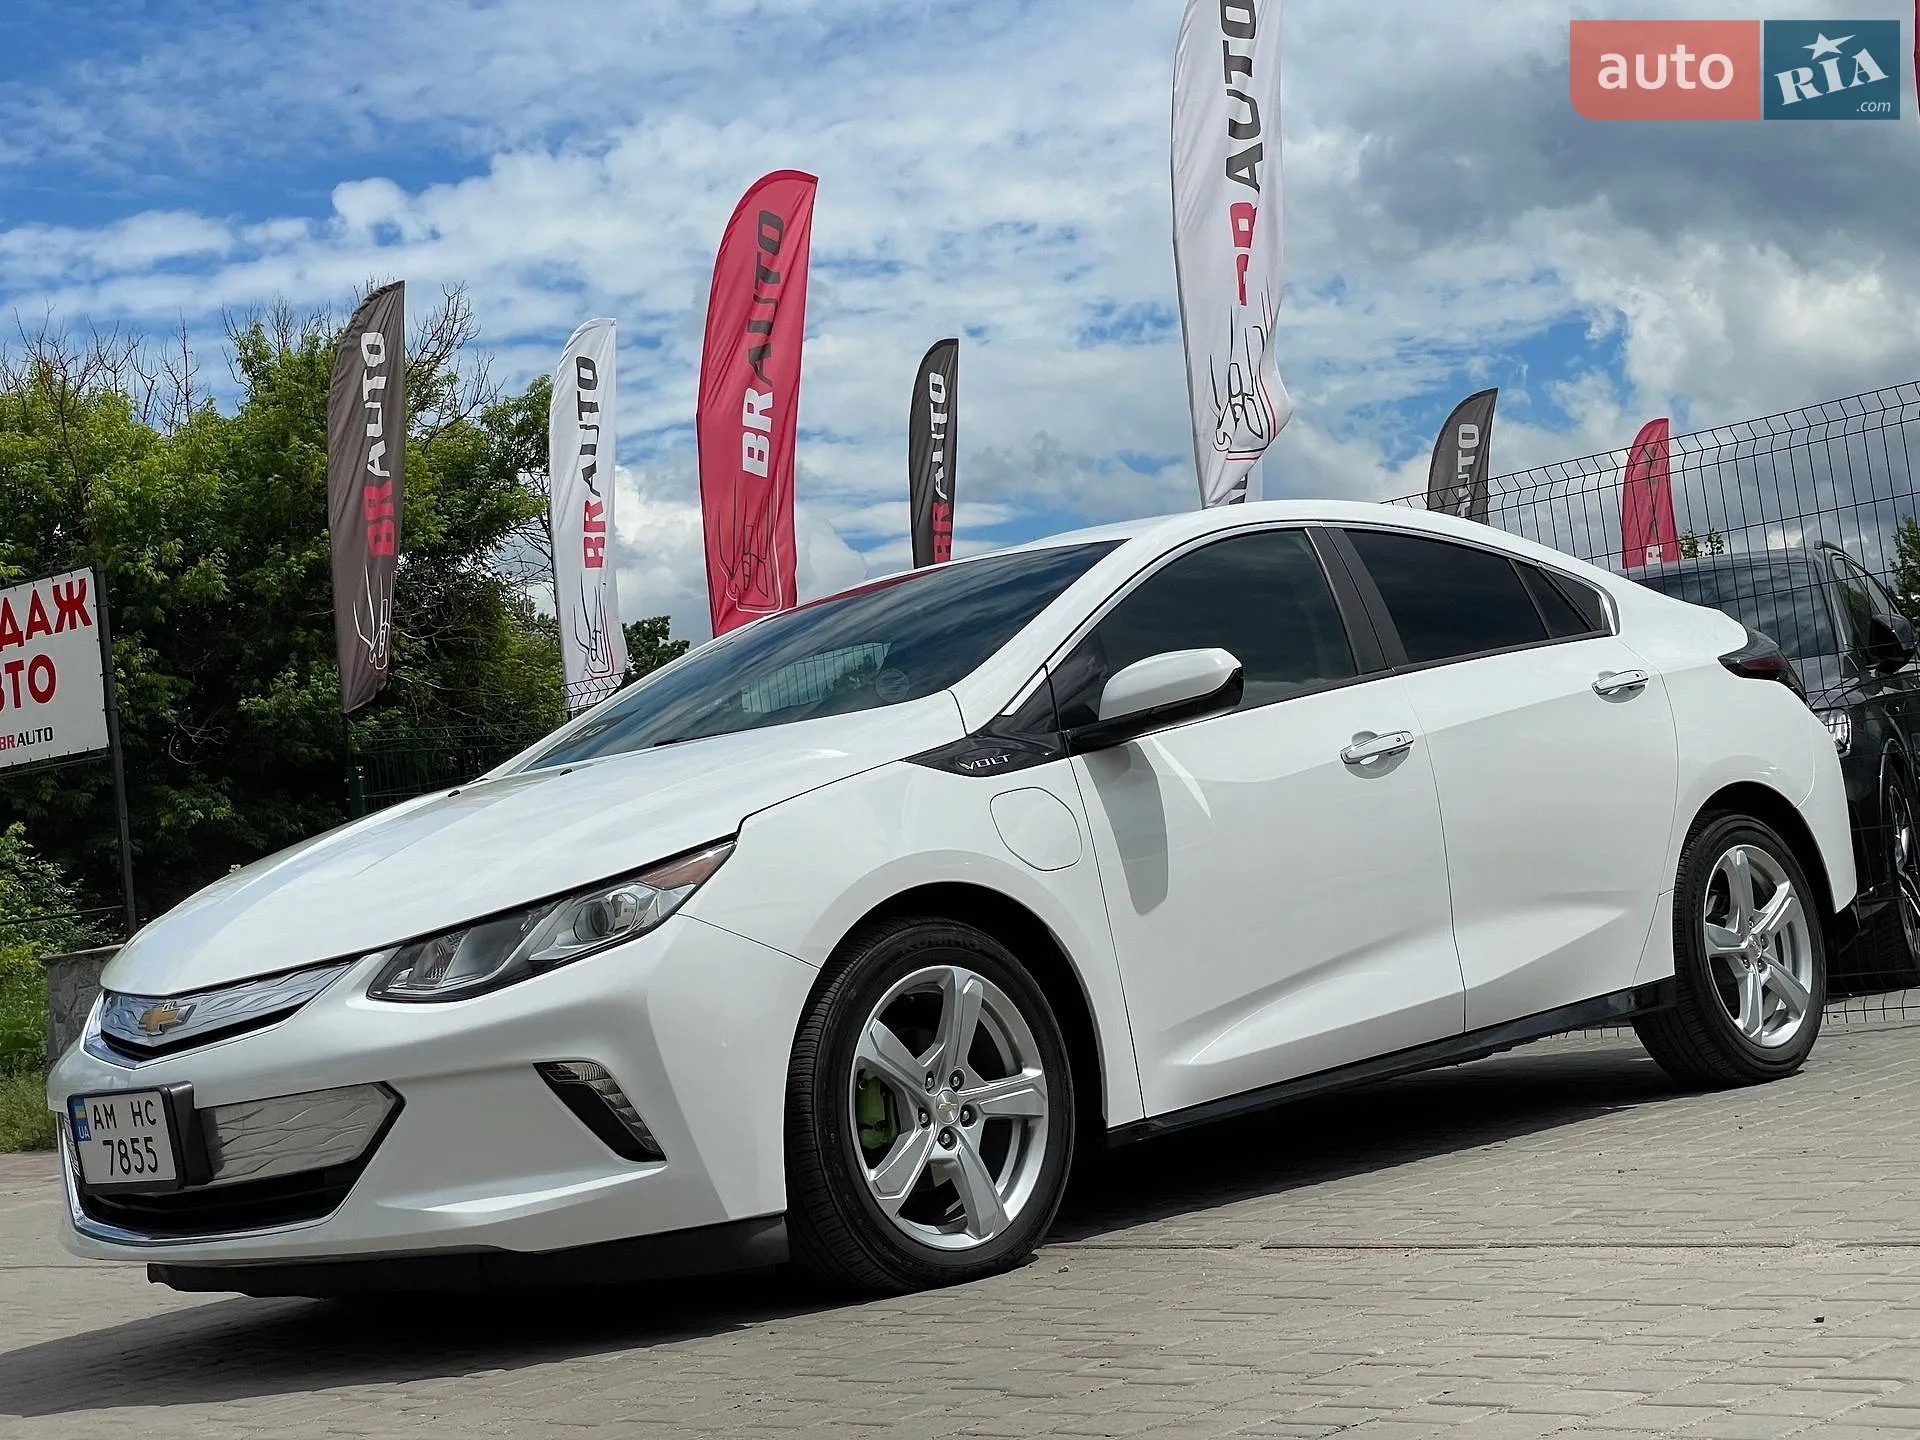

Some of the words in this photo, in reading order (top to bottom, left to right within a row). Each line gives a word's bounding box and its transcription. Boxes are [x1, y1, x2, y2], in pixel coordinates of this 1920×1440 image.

[742, 208, 785, 478] BRAUTO
[360, 331, 395, 557] BRAUTO
[575, 355, 607, 570] BRAUTO
[0, 654, 57, 712] ТО
[0, 726, 54, 751] BRAUTO
[958, 753, 1011, 770] VOLT
[77, 1125, 91, 1140] UA
[93, 1103, 117, 1130] AM
[130, 1100, 157, 1127] HC
[102, 1136, 159, 1176] 7855
